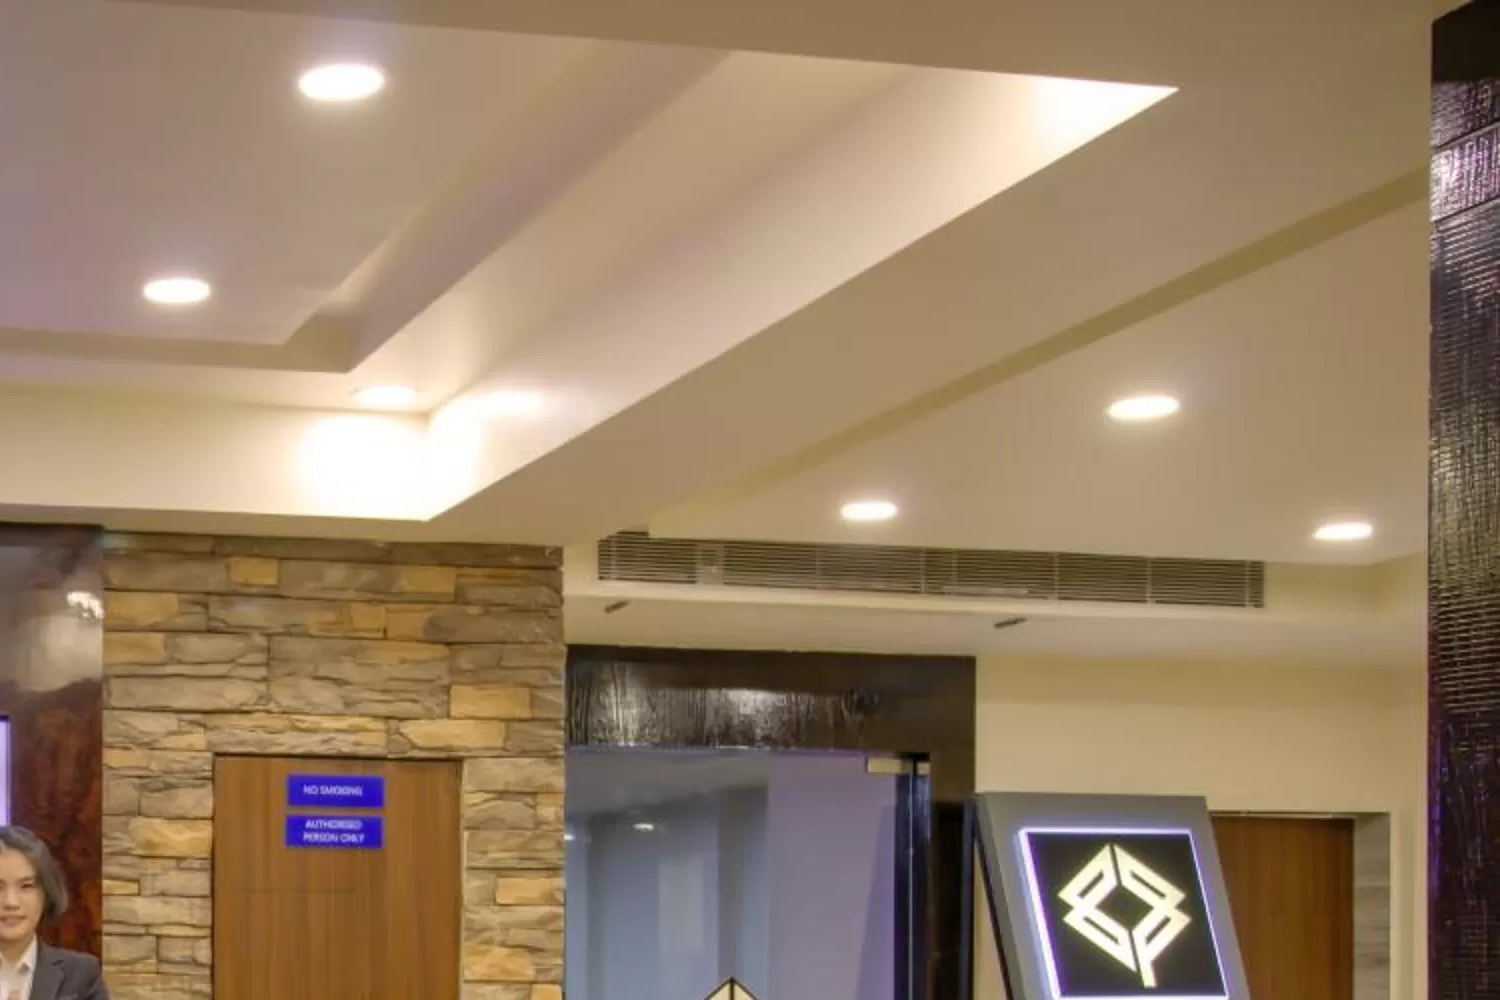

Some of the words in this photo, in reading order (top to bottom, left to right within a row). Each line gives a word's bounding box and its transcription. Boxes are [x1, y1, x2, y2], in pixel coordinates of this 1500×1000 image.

[303, 784, 319, 795] NO
[320, 784, 363, 796] SMOKING
[340, 832, 365, 844] ONLY
